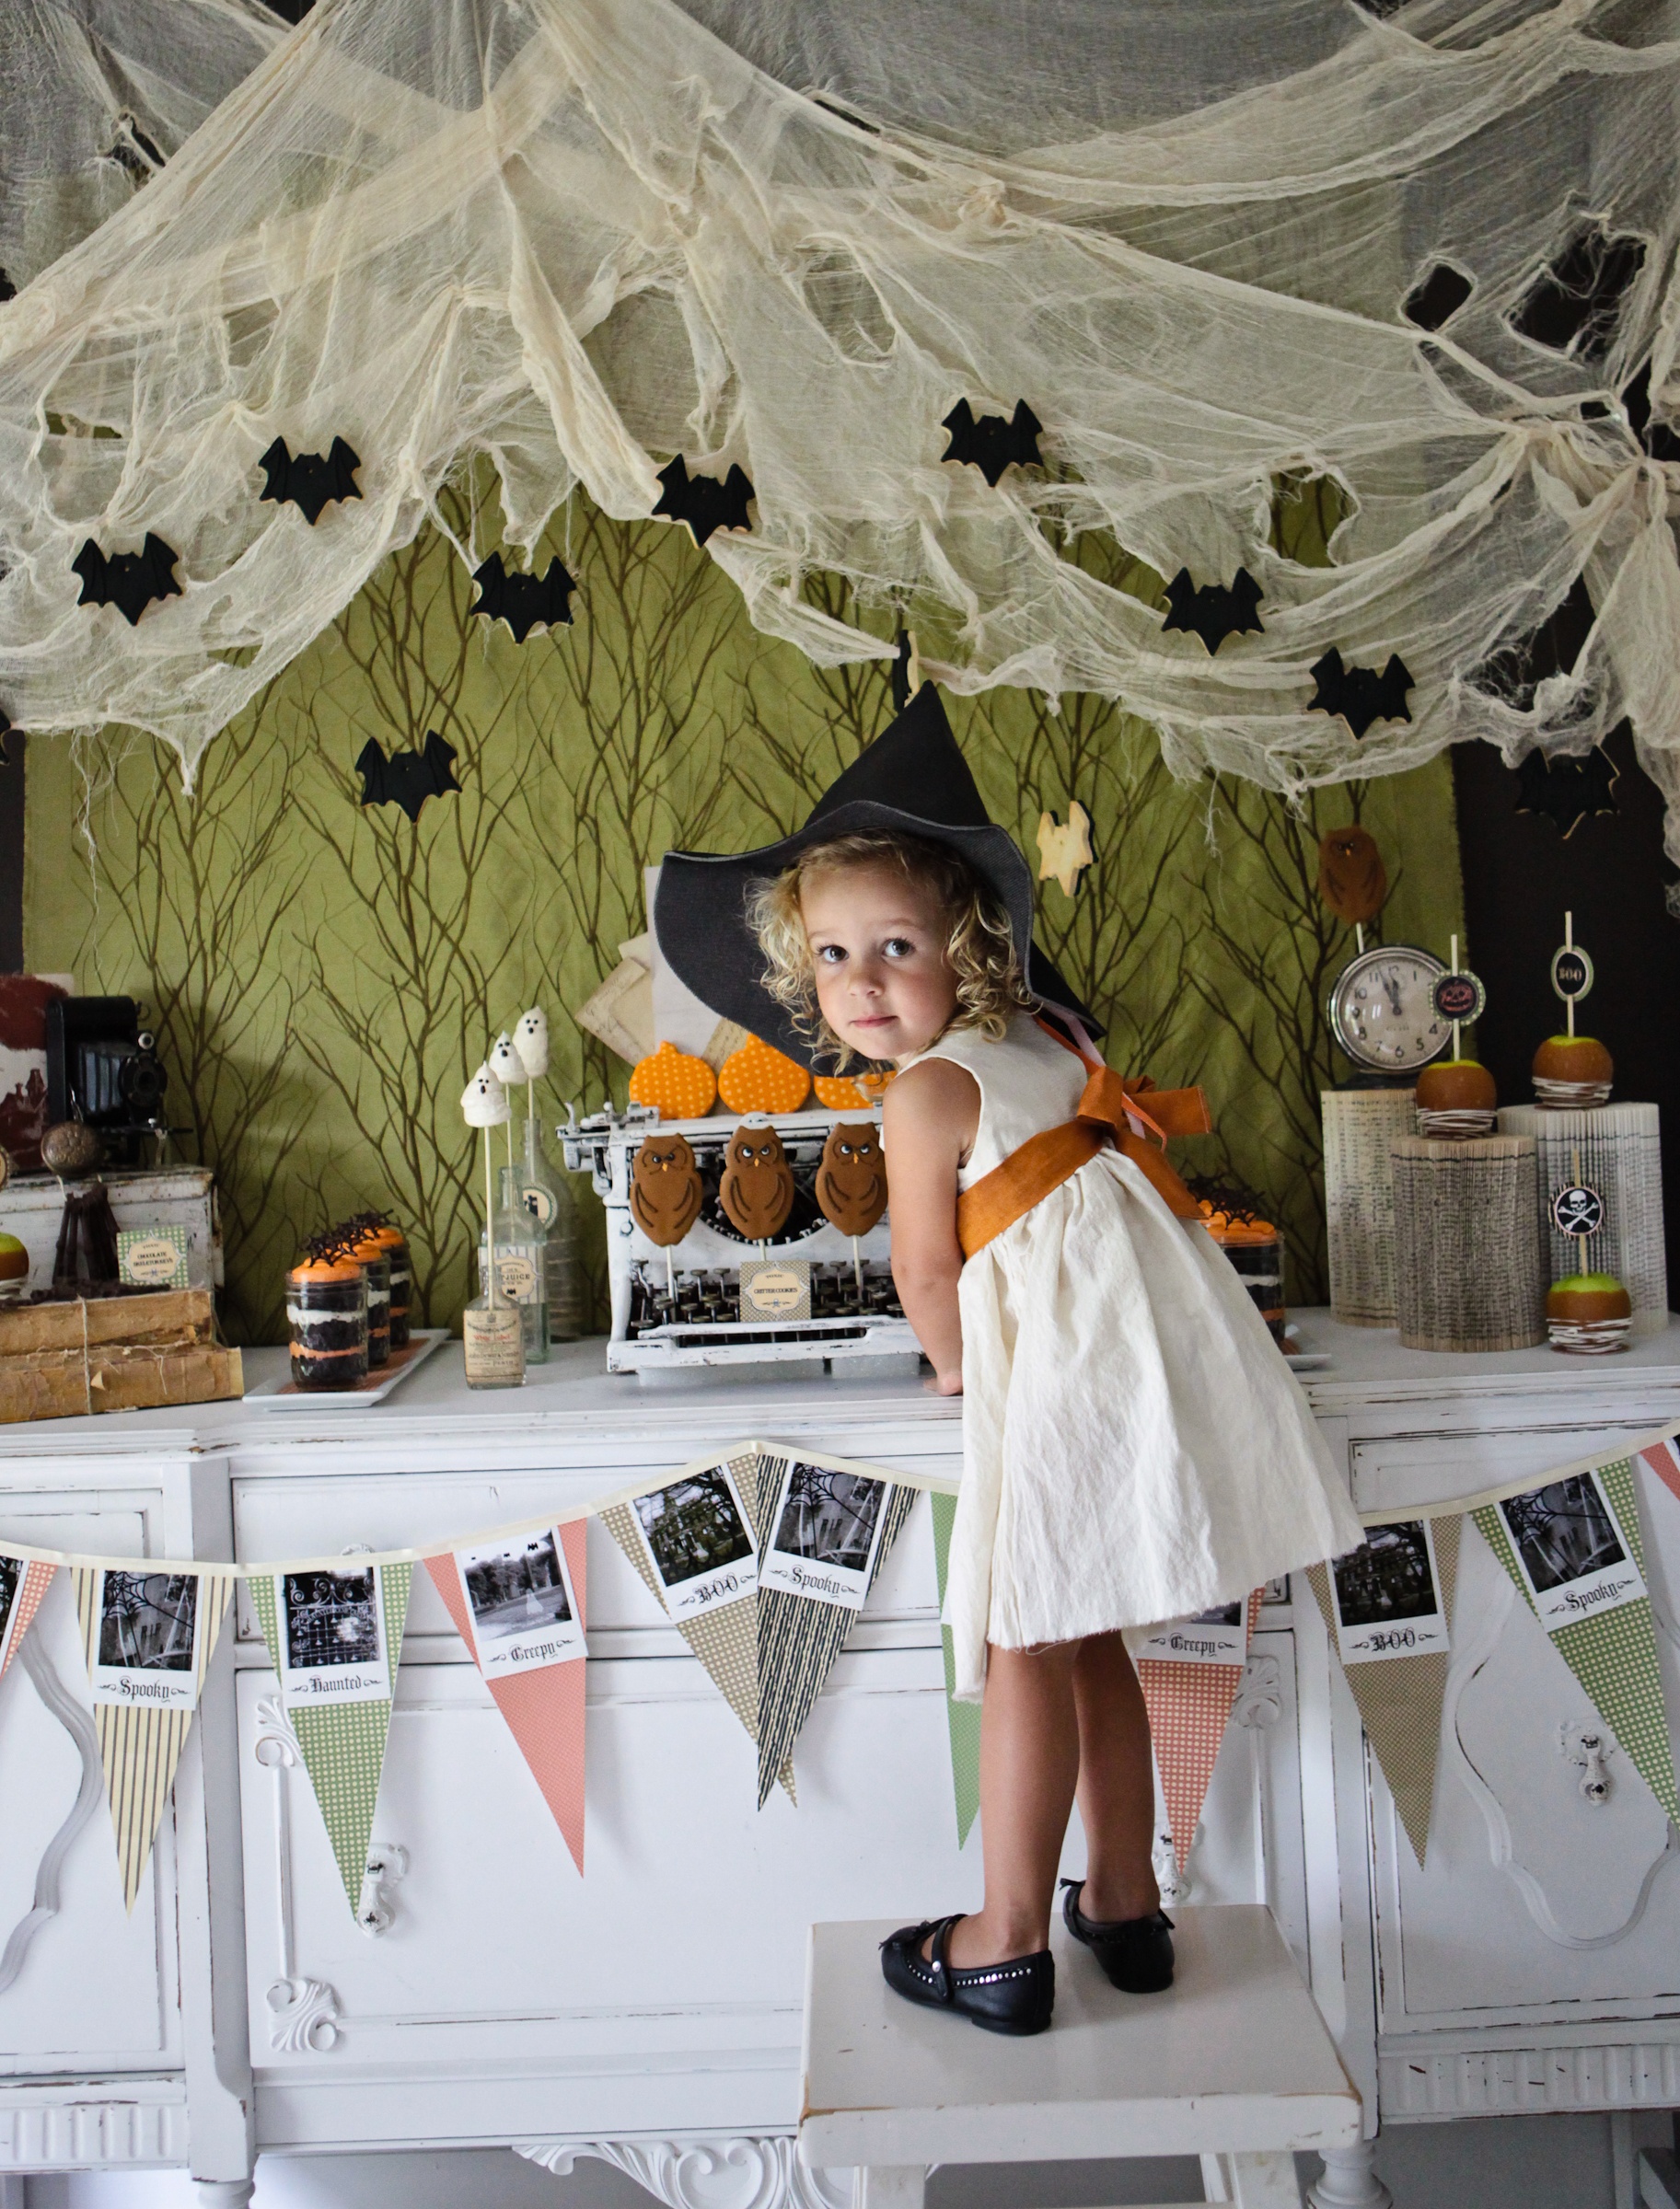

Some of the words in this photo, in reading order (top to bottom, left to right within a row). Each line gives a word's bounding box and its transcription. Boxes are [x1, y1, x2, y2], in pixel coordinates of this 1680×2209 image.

[1369, 972, 1379, 983] 11
[1413, 970, 1418, 982] 1
[1354, 987, 1368, 1000] 10
[1352, 1006, 1361, 1019] 9
[1358, 1026, 1367, 1040] 8
[1429, 1023, 1438, 1035] 4
[1395, 1046, 1404, 1058] 6
[1416, 1037, 1425, 1050] 5
[691, 1571, 740, 1604] BOO
[787, 1564, 840, 1599] Spooky
[1562, 1579, 1622, 1615] Spooky
[141, 1622, 163, 1639] RIP
[1368, 1626, 1416, 1652] BOO
[509, 1642, 559, 1662] Creepy
[1167, 1632, 1218, 1659] Creepy
[117, 1675, 171, 1704] Spooky
[308, 1675, 362, 1694] Haunted
